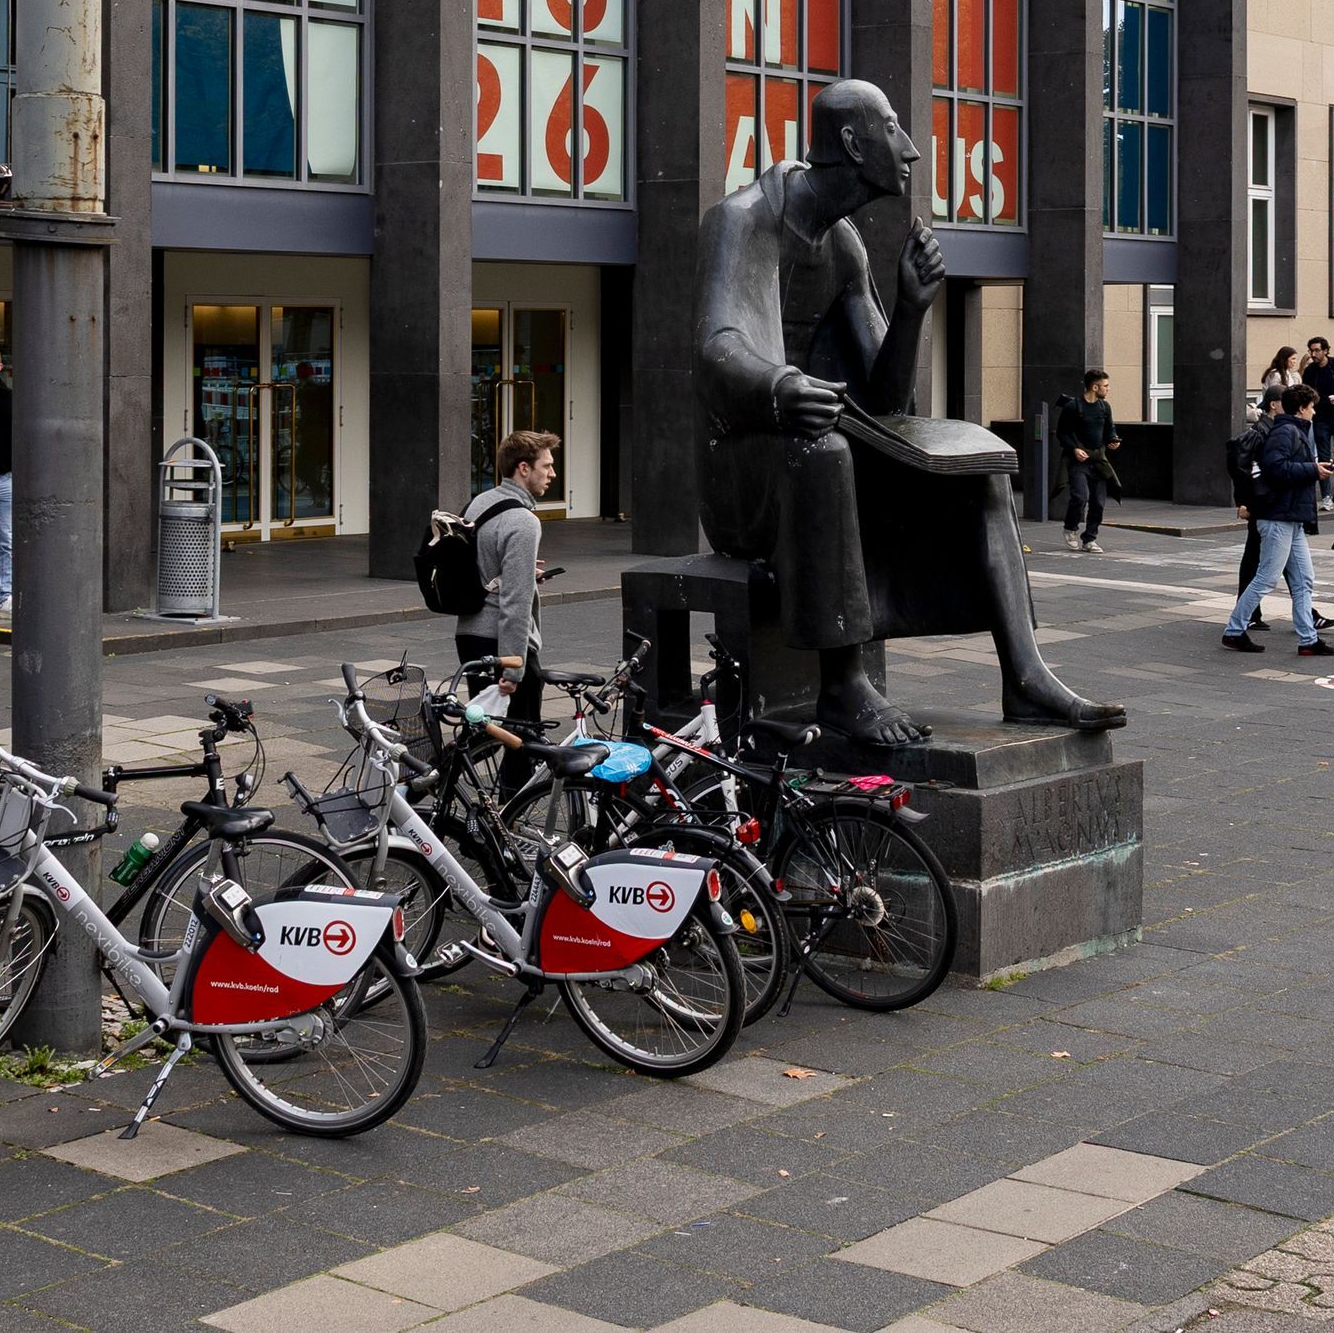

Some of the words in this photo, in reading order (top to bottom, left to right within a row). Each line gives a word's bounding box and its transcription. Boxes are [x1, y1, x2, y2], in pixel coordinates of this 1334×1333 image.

[477, 53, 610, 186] 26
[408, 828, 423, 846] KVB
[42, 871, 60, 889] KVB
[436, 863, 497, 933] nextbike
[609, 885, 645, 906] KVB
[184, 918, 200, 949] 222012
[280, 926, 321, 948] KVB
[552, 934, 612, 948] www.kvb.koeln/rad
[75, 909, 142, 988] nextbike
[210, 979, 280, 994] www.kvb.koeln/rad
